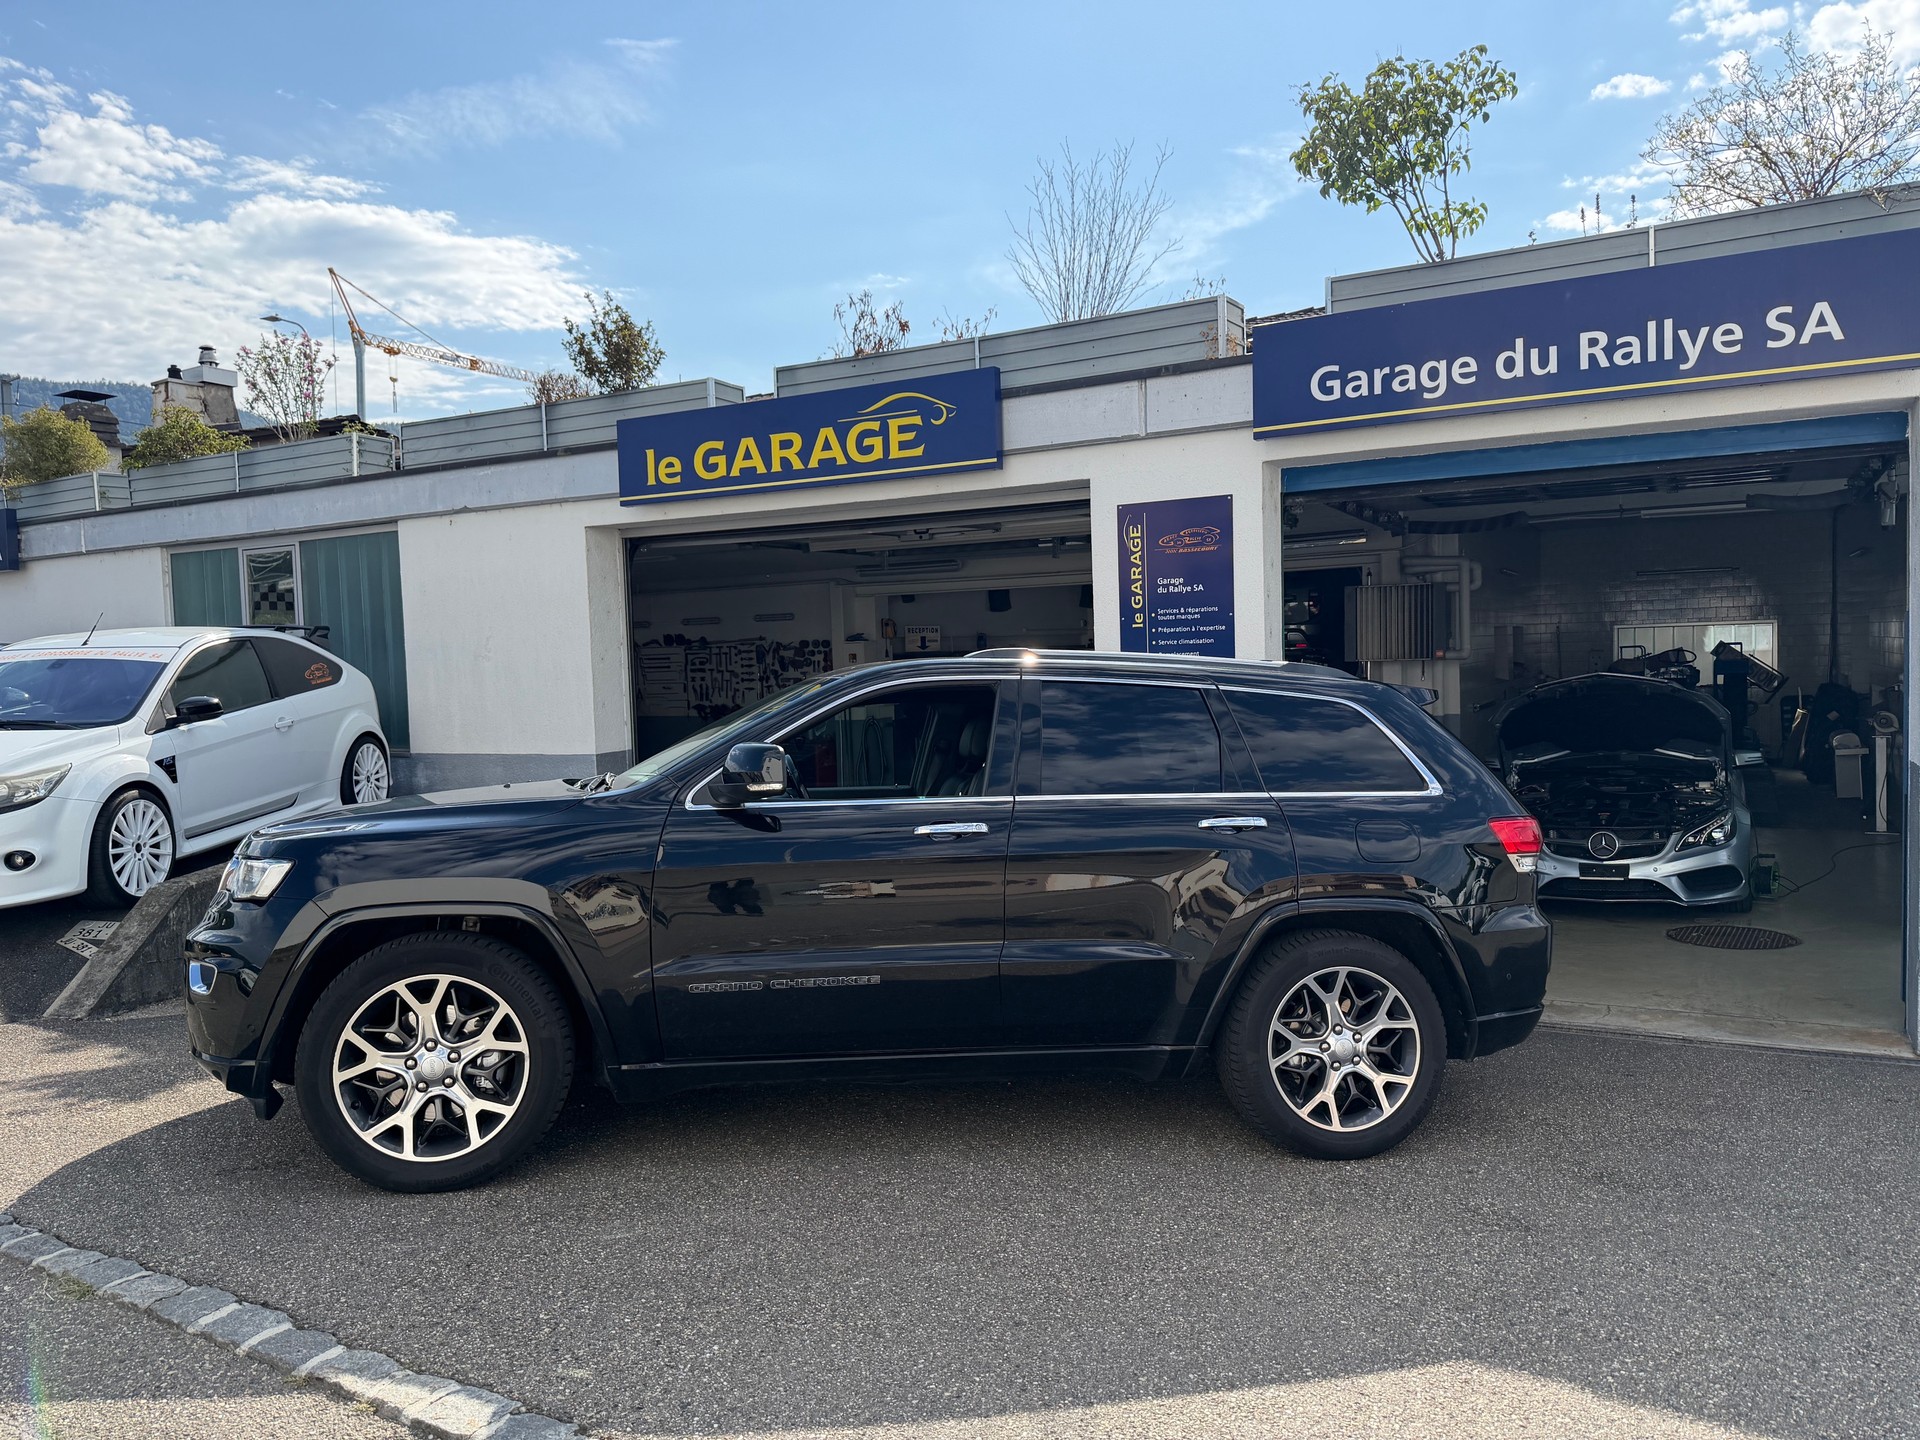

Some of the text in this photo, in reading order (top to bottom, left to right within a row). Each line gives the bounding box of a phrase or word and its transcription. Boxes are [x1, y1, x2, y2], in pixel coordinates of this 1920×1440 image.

[1311, 302, 1846, 401] Garage du Rallye SA
[645, 415, 925, 486] le GARAGE
[1129, 524, 1144, 628] le GARAGE
[1157, 577, 1184, 585] Garage
[1157, 584, 1204, 594] du Rallye SA
[98, 921, 116, 929] JU
[688, 974, 881, 994] GRAND CHEROKEE
